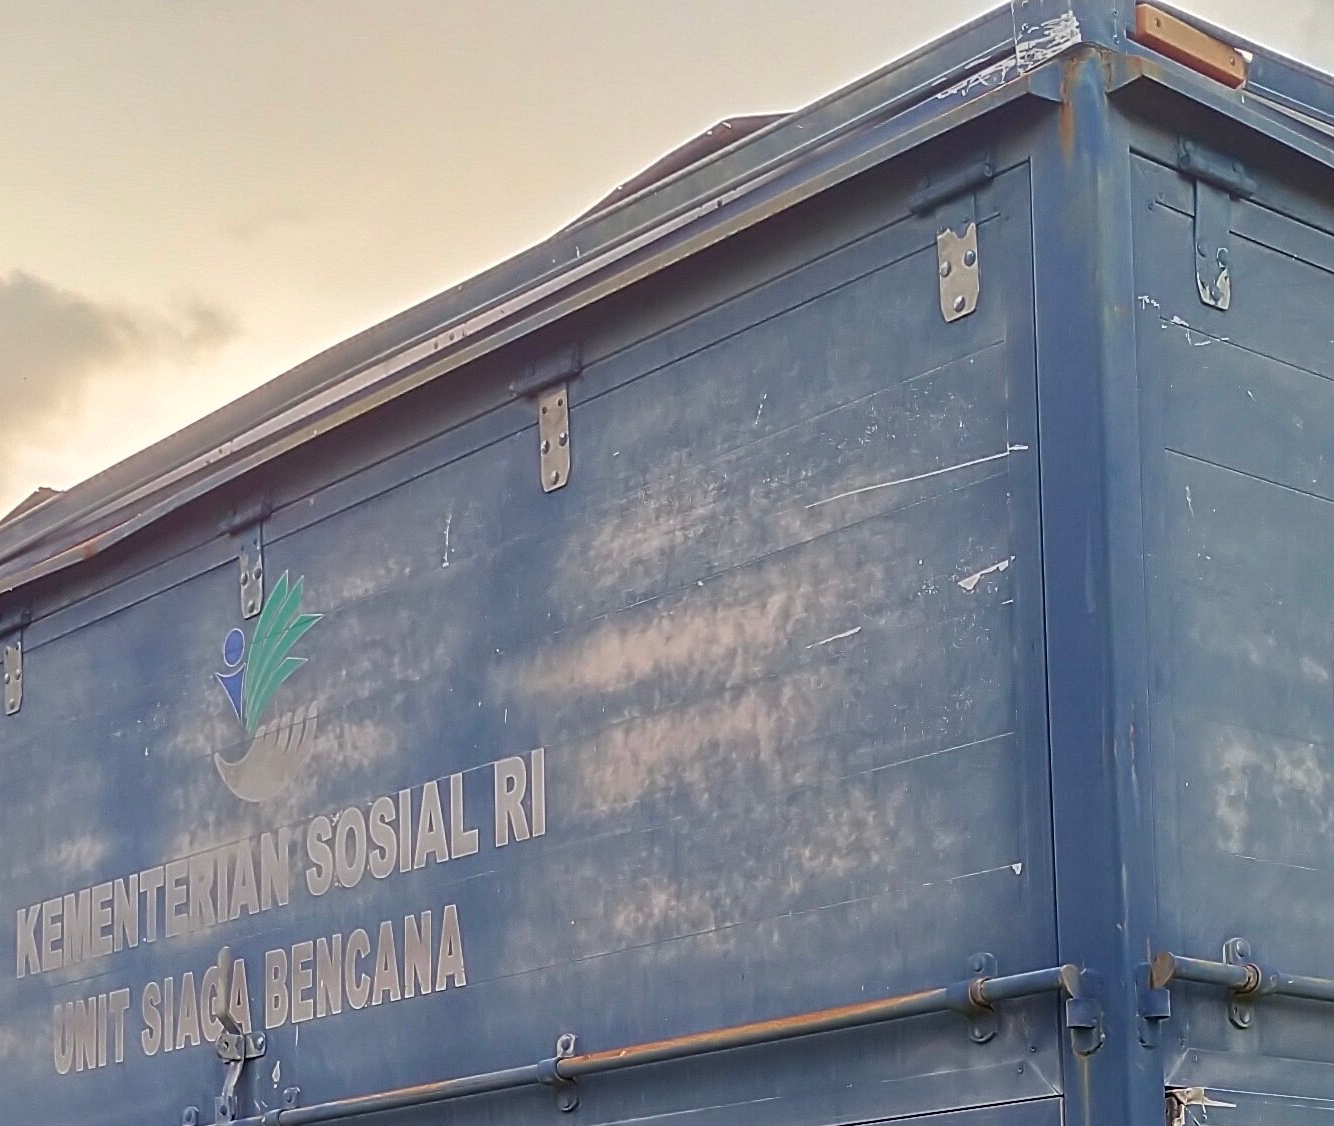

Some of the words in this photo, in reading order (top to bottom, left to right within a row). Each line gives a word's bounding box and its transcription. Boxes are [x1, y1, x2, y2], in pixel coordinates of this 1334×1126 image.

[16, 828, 289, 978] KEMENTERIAN
[305, 770, 479, 896] SOSIAL
[493, 747, 547, 848] RI
[53, 987, 131, 1076] UNIT
[265, 903, 468, 1030] BENCANA
